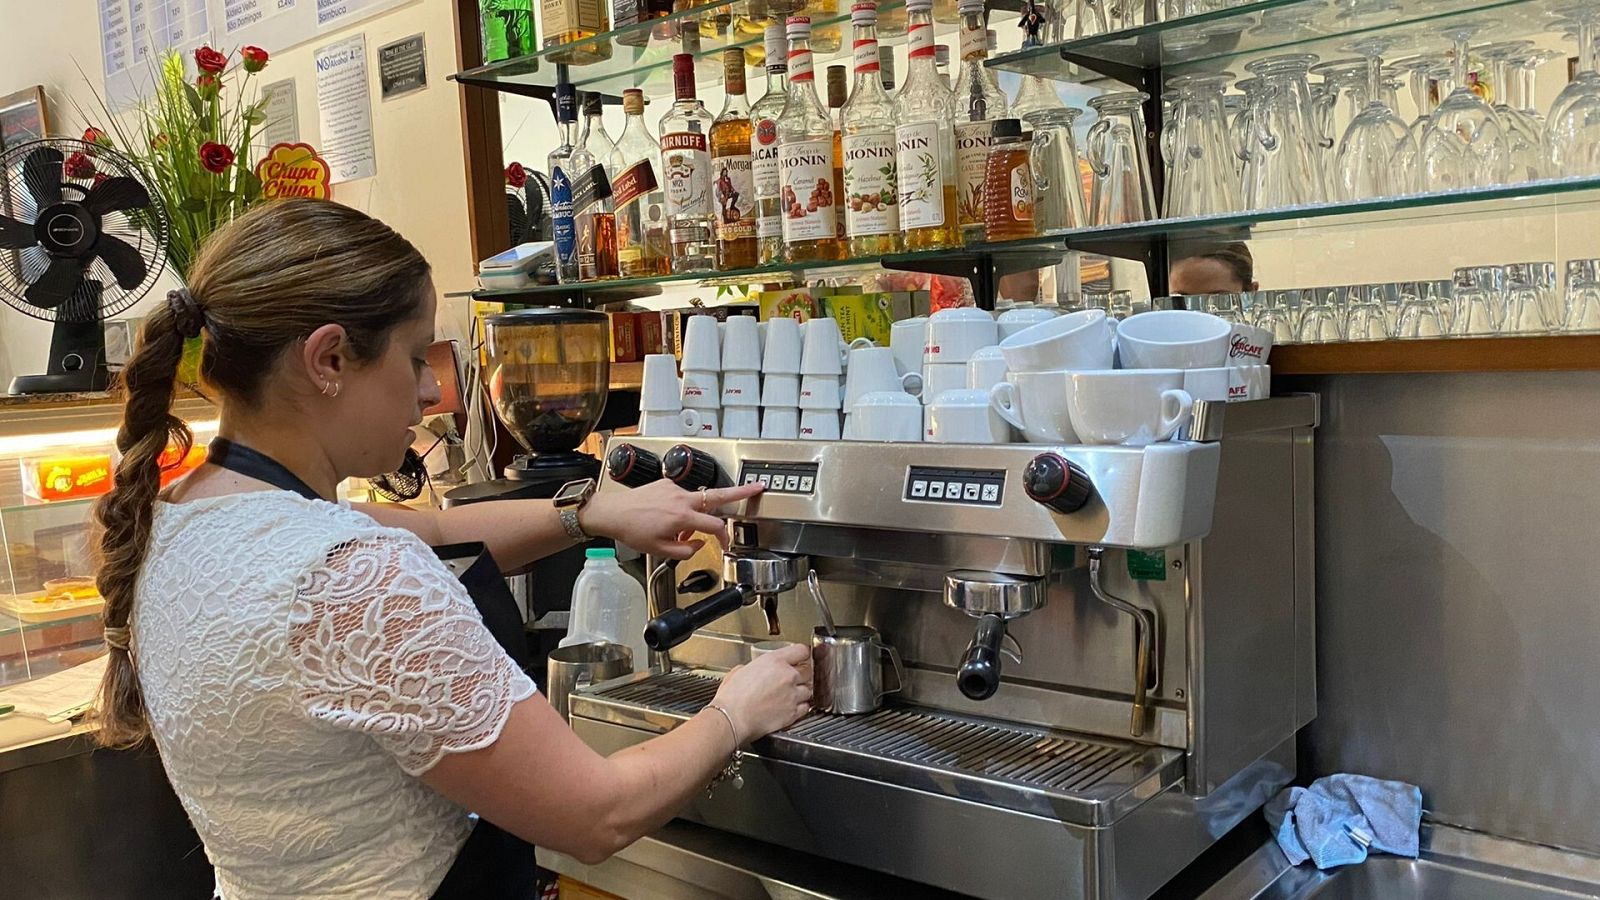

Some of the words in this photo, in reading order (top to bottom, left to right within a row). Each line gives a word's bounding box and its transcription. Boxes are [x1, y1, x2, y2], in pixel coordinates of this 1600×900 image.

[781, 154, 827, 169] MONIN
[846, 147, 894, 161] MONIN
[268, 161, 320, 184] Chupa
[264, 180, 317, 200] Chups
[622, 176, 637, 192] Label
[733, 225, 752, 233] GOLD
